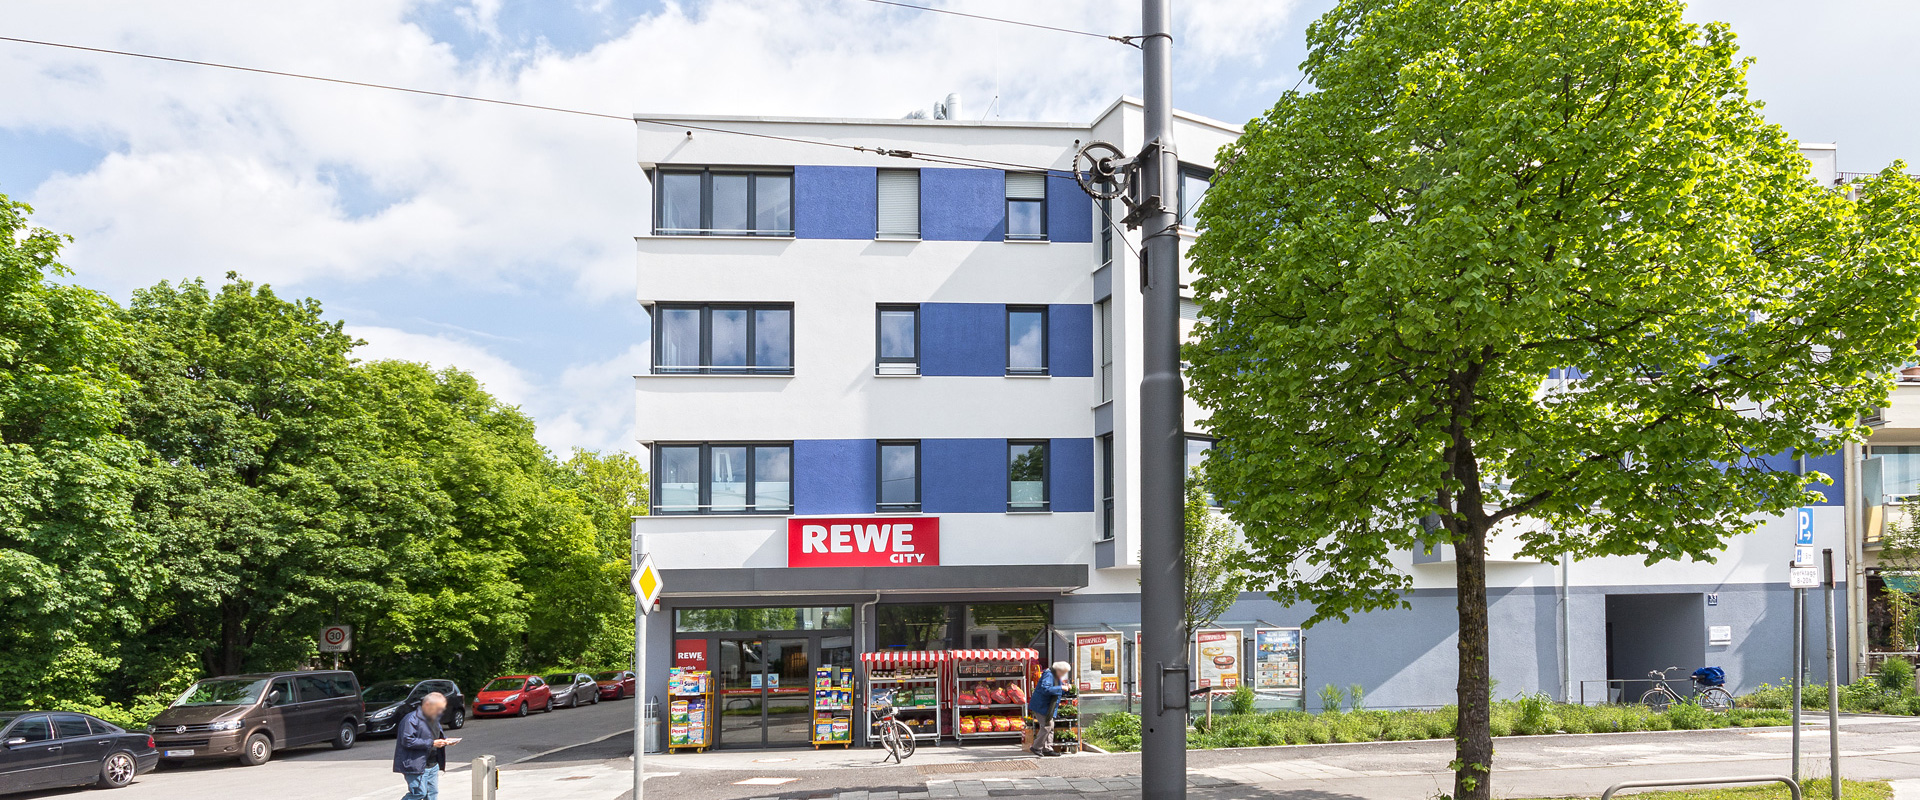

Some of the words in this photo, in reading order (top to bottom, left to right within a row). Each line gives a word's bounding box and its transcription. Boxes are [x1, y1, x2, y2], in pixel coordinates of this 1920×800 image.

[1799, 511, 1809, 540] P
[802, 523, 915, 554] REWE
[889, 553, 925, 564] CITY
[329, 631, 341, 640] 30
